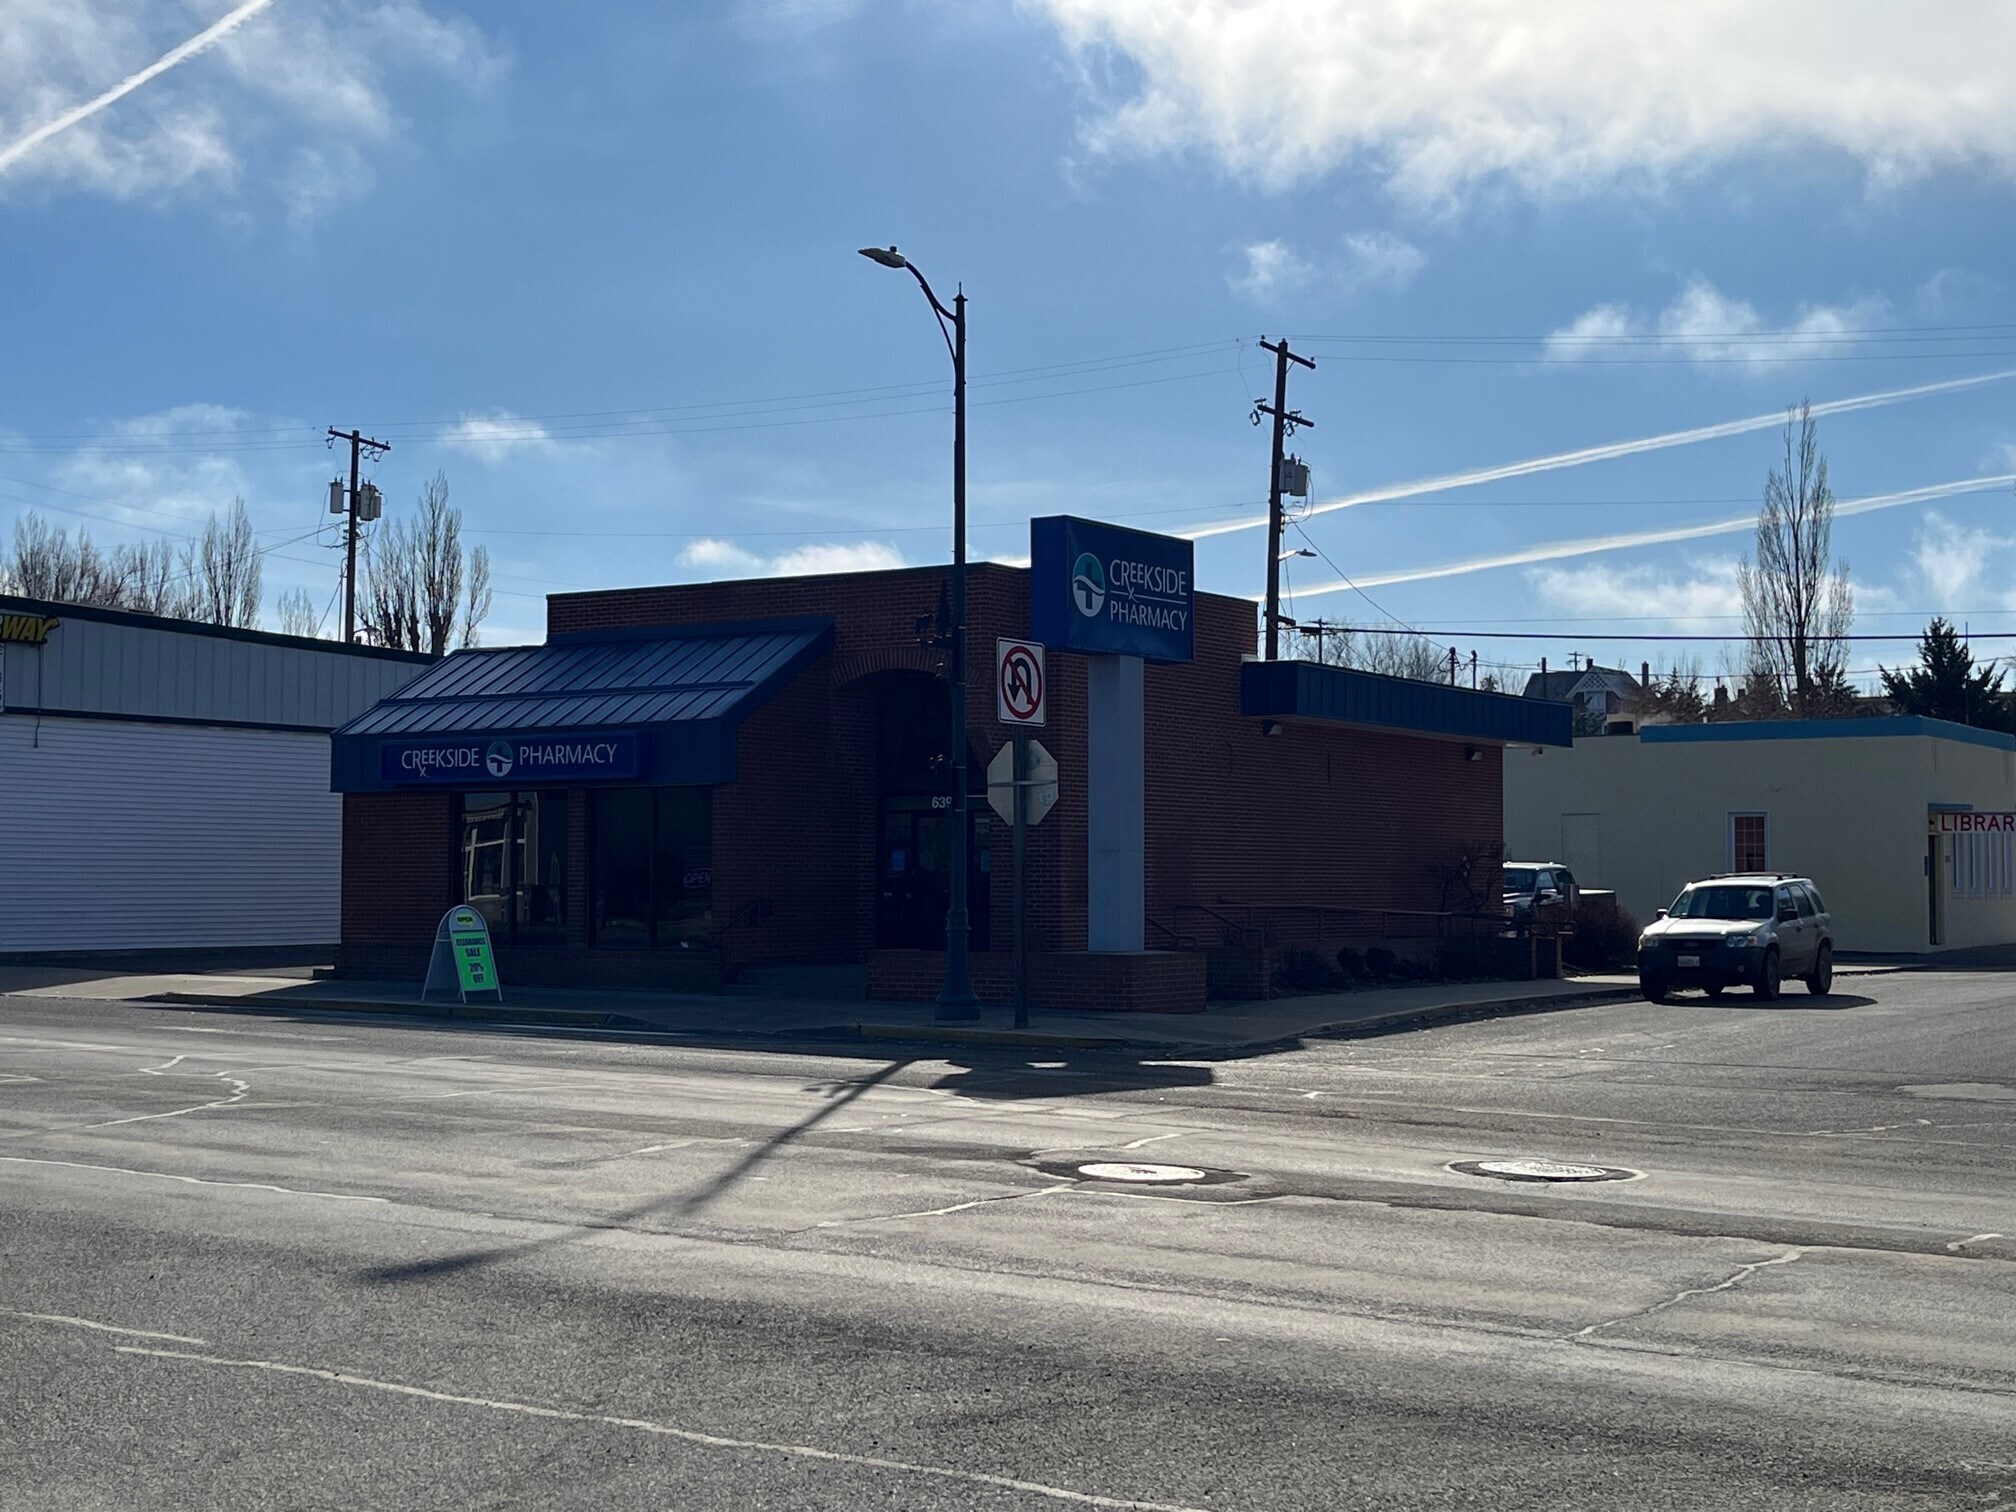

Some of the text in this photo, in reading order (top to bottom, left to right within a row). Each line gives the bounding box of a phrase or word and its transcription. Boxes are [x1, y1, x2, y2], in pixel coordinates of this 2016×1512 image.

[1109, 559, 1187, 602] CREEKSIDE
[0, 614, 60, 641] WAY
[1110, 600, 1188, 631] PHARMACY
[401, 743, 618, 777] CREEKSIDE PHARMACY
[1941, 815, 2015, 832] LIBRAR
[685, 871, 712, 885] OPEN
[465, 947, 482, 958] SALE
